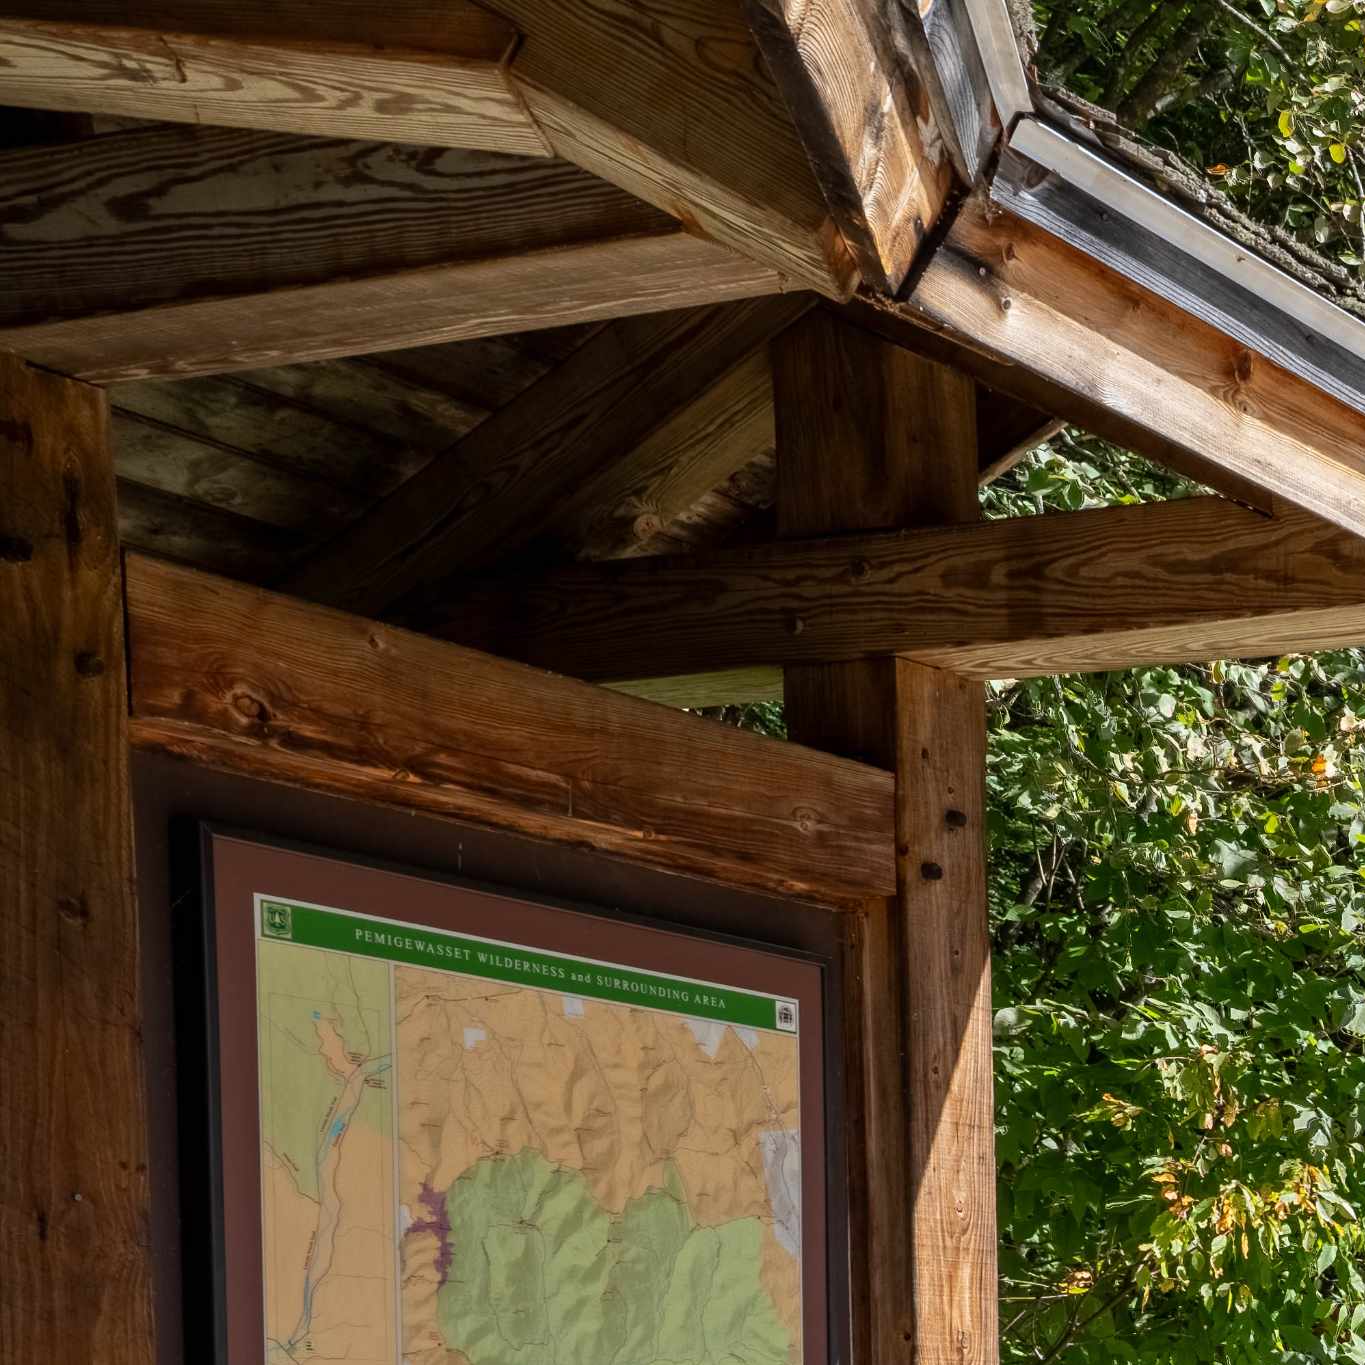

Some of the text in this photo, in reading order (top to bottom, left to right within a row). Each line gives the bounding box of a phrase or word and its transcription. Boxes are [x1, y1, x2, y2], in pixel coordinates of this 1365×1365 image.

[356, 928, 726, 1008] PEMIGEWASSET WILDERNESS and SURROUNDING AREA
